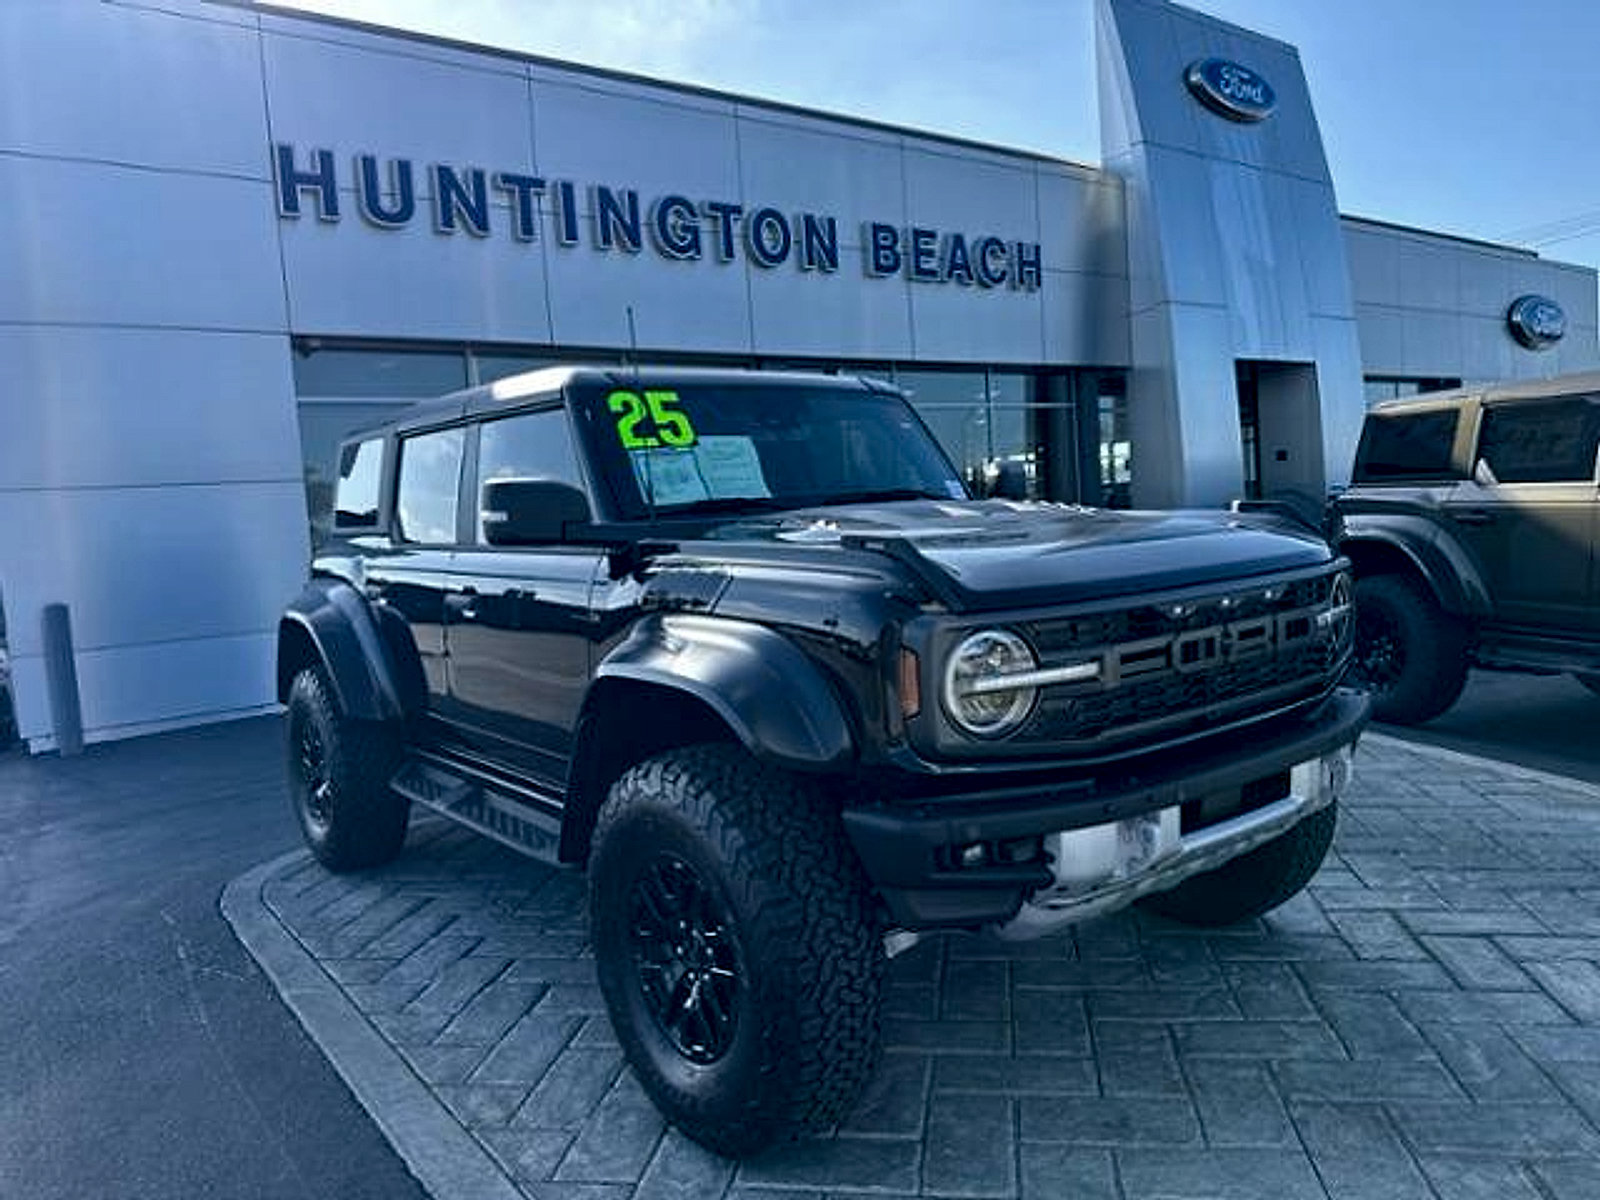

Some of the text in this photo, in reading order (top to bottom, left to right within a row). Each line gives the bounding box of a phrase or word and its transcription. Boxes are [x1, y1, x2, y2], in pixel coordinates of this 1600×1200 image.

[1219, 65, 1264, 104] Ford
[276, 144, 1042, 291] HUNTINGTON BEACH
[606, 389, 696, 449] 25
[1101, 608, 1320, 690] FORD
